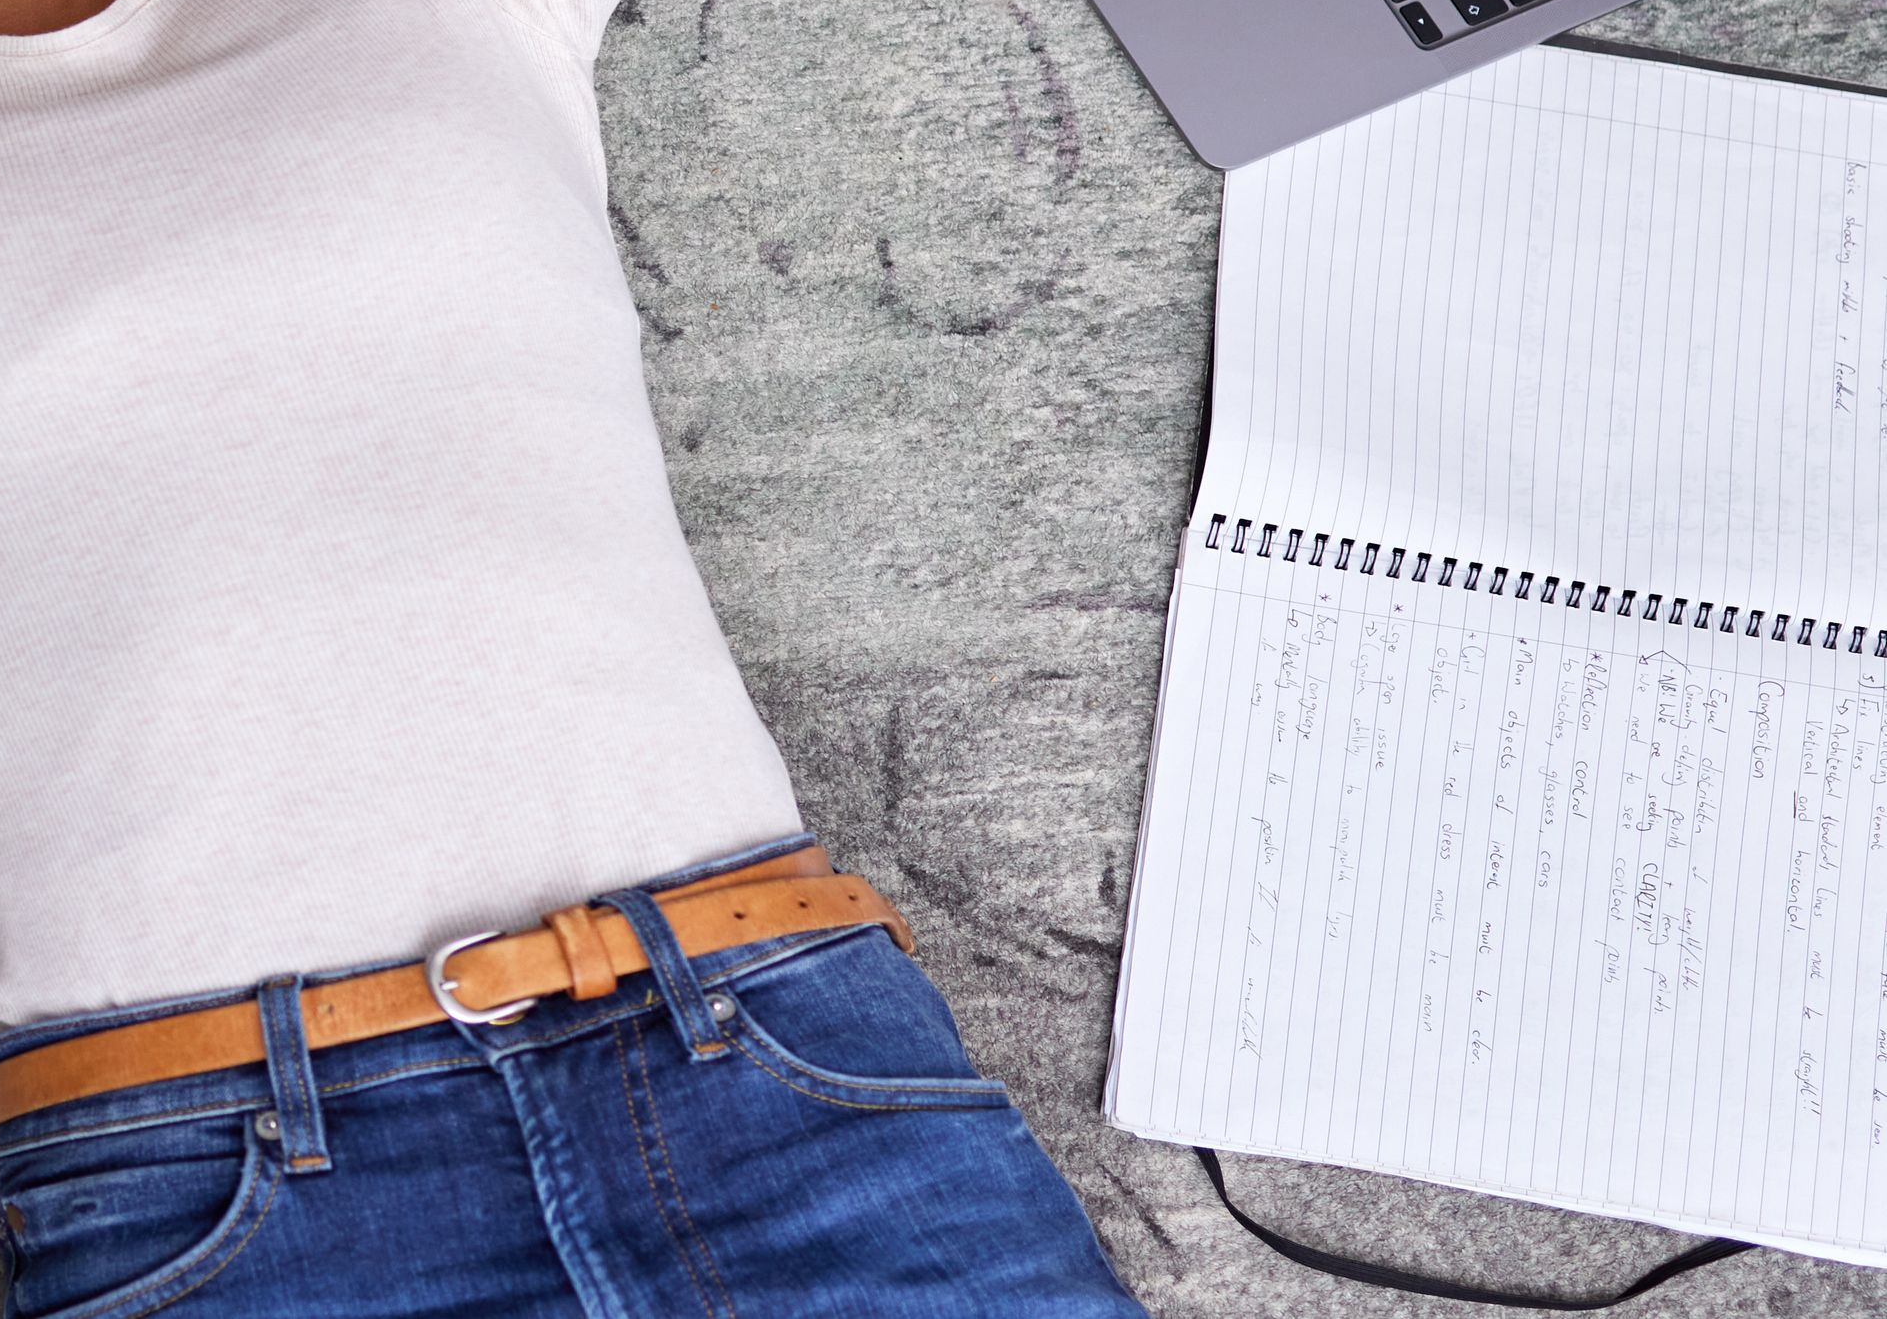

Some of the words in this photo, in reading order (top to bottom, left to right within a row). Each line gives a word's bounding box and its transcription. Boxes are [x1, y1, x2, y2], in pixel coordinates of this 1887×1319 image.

[1431, 648, 1452, 704] object.
[1514, 649, 1534, 686] Main
[1295, 676, 1327, 741] language
[1457, 698, 1469, 710] in
[1656, 703, 1676, 723] We
[1702, 688, 1727, 733] Equal
[1499, 711, 1519, 769] objects
[1630, 717, 1643, 741] need
[1749, 681, 1785, 778] Composition
[1374, 729, 1387, 771] issue
[1451, 740, 1473, 757] the
[1802, 720, 1823, 775] Vertical
[1852, 741, 1875, 769] lines
[1345, 786, 1360, 795] to
[1442, 778, 1459, 797] red
[1571, 761, 1590, 818] control
[1623, 772, 1642, 785] to
[1621, 807, 1634, 829] see
[1870, 807, 1886, 849] element
[1440, 824, 1462, 860] dress
[1538, 851, 1552, 888] cars
[1431, 890, 1446, 923] must
[1610, 858, 1628, 921] contact
[1636, 863, 1658, 934] CLARITY!
[1478, 922, 1493, 953] must
[1428, 951, 1448, 964] be
[1808, 951, 1823, 979] must
[1422, 994, 1435, 1032] main
[1475, 989, 1494, 1003] be
